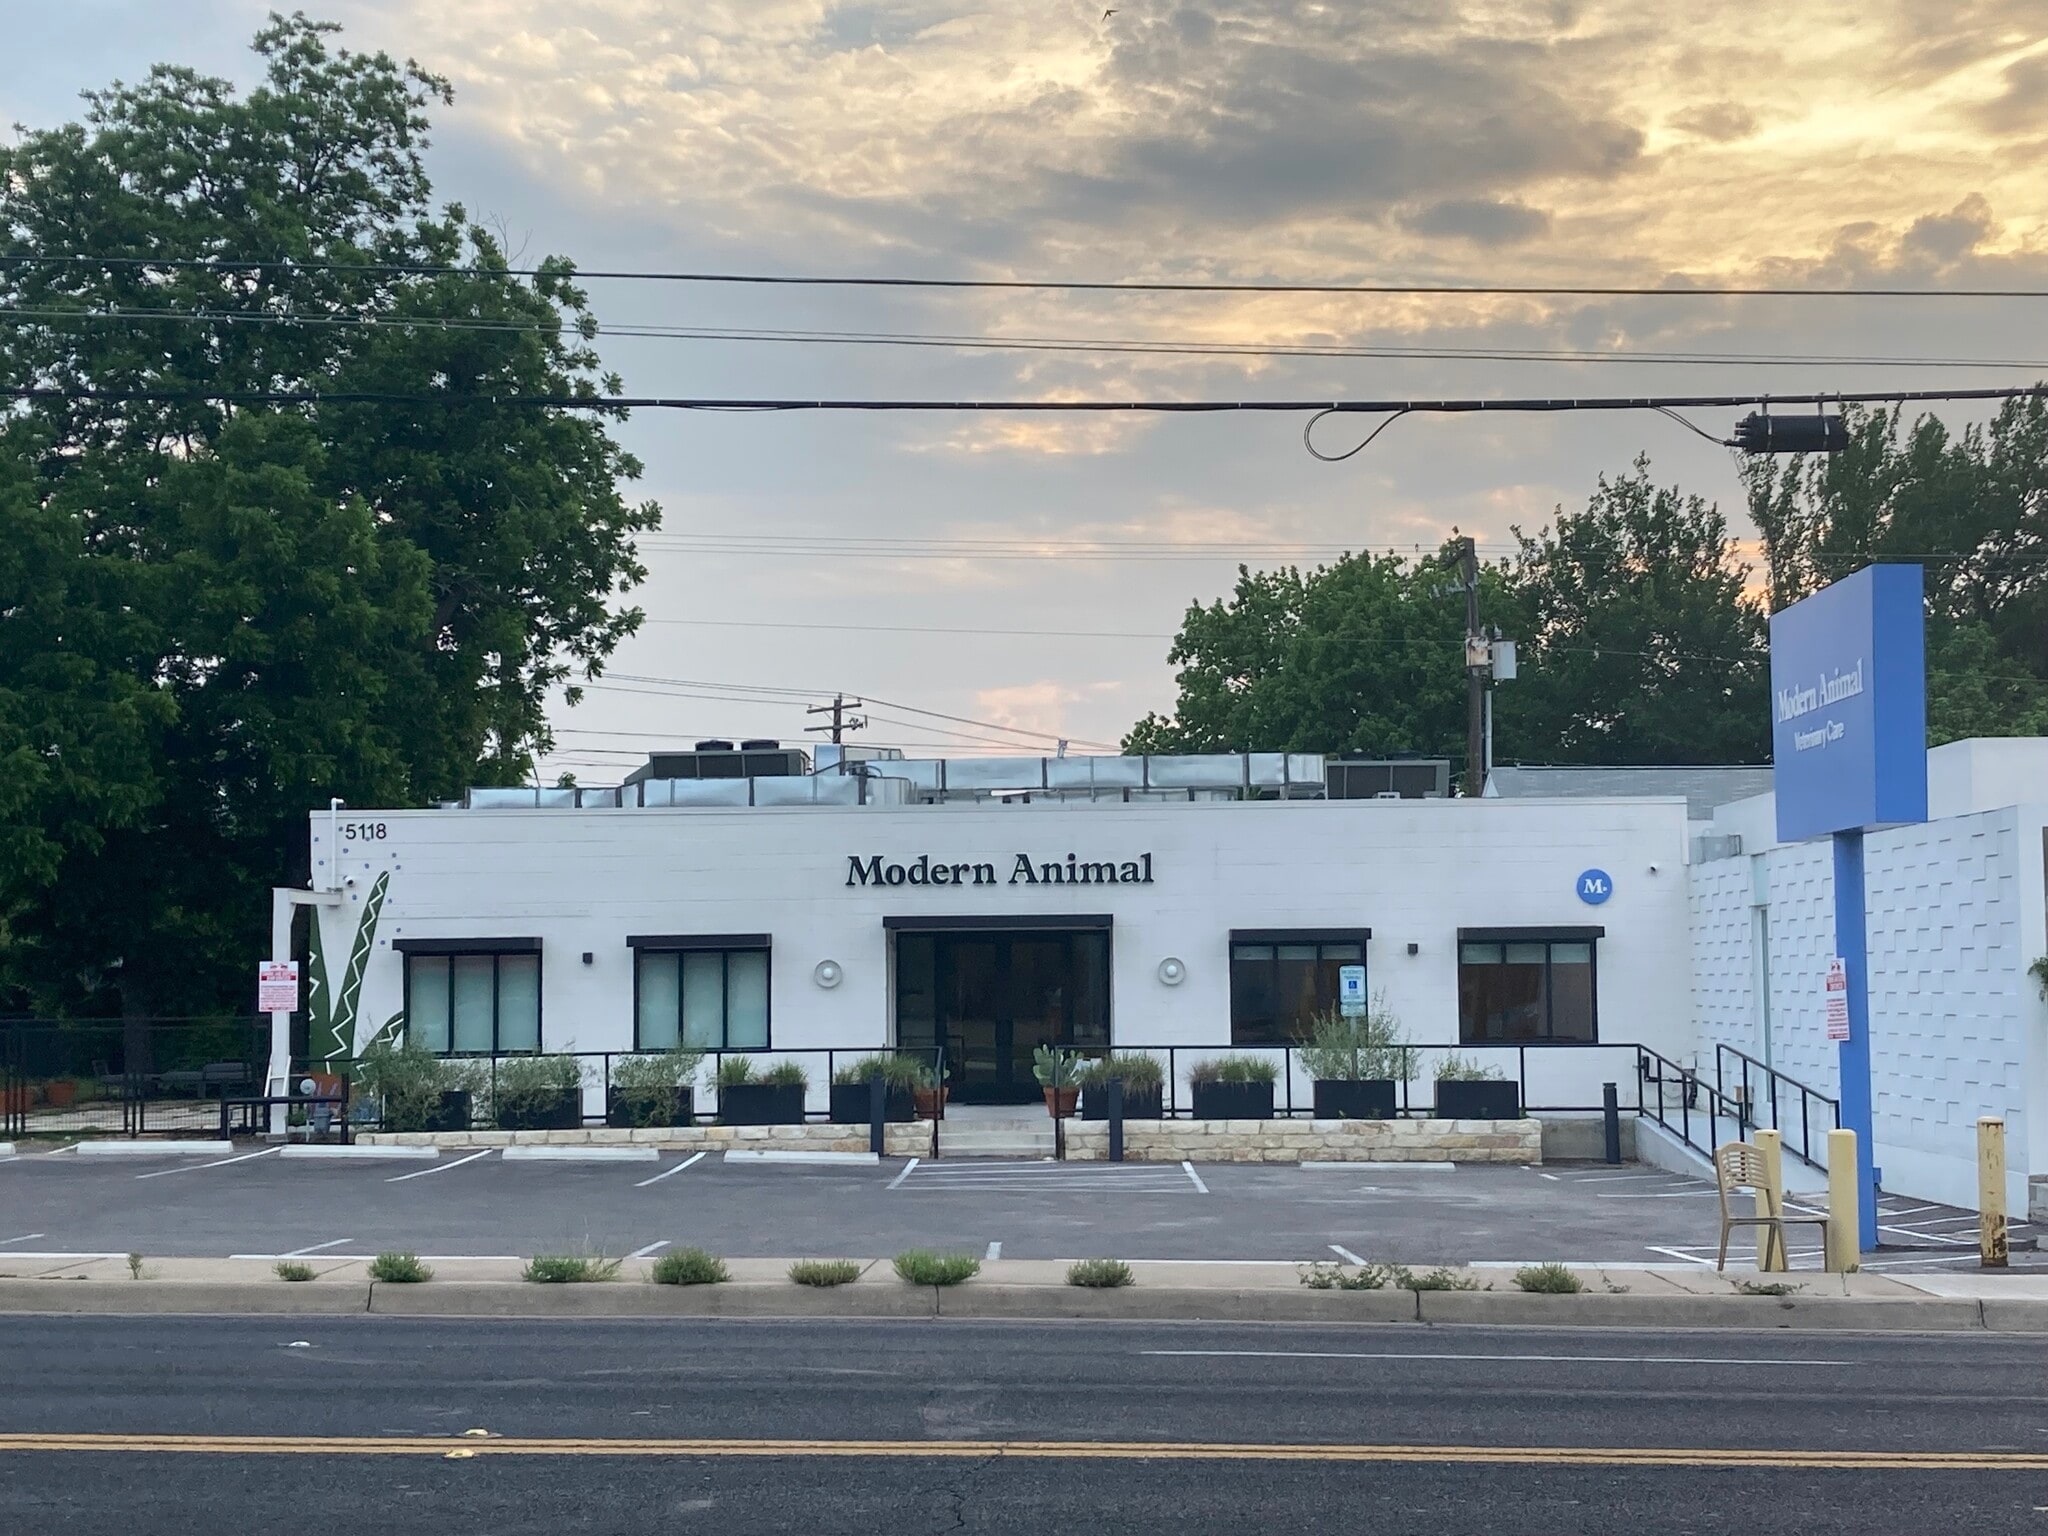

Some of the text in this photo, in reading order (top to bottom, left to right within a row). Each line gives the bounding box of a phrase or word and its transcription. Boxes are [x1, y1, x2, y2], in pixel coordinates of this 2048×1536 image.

[1778, 657, 1864, 723] Modern Animal
[1827, 719, 1844, 741] Care
[345, 823, 387, 840] 5118
[845, 852, 1155, 886] Modern Animal
